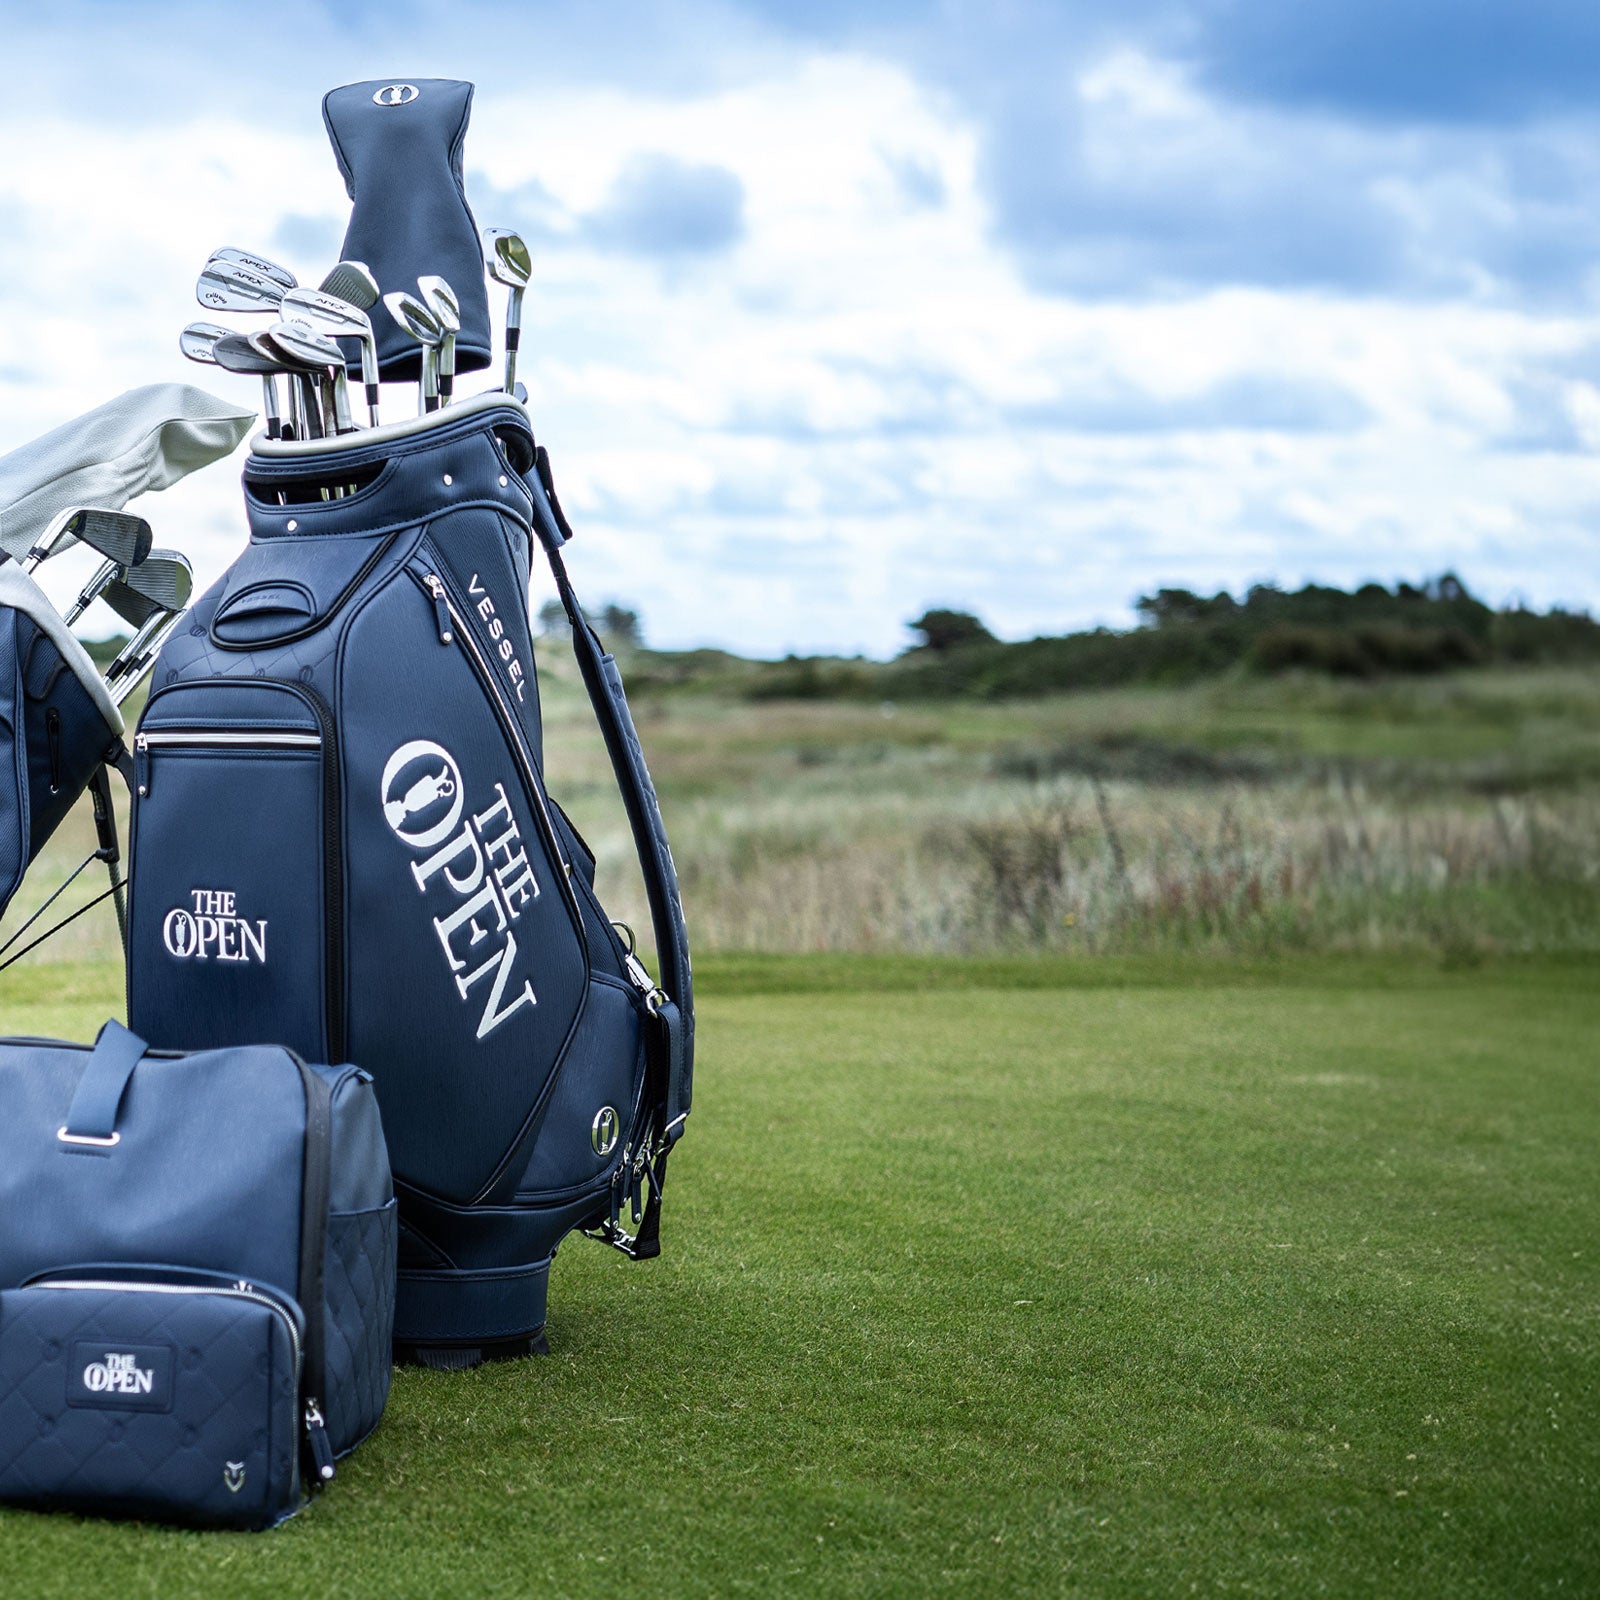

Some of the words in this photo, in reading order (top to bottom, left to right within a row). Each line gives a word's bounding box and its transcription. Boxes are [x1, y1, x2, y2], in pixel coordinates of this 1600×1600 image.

[232, 271, 265, 286] APEX
[239, 258, 272, 272] APEX
[315, 297, 348, 310] APEX
[468, 573, 525, 702] VESSEL
[473, 783, 540, 918] THE
[191, 889, 237, 917] THE
[381, 739, 537, 1039] OPEN
[163, 908, 268, 963] OPEN
[104, 1352, 136, 1370] THE
[83, 1362, 155, 1393] OPEN
